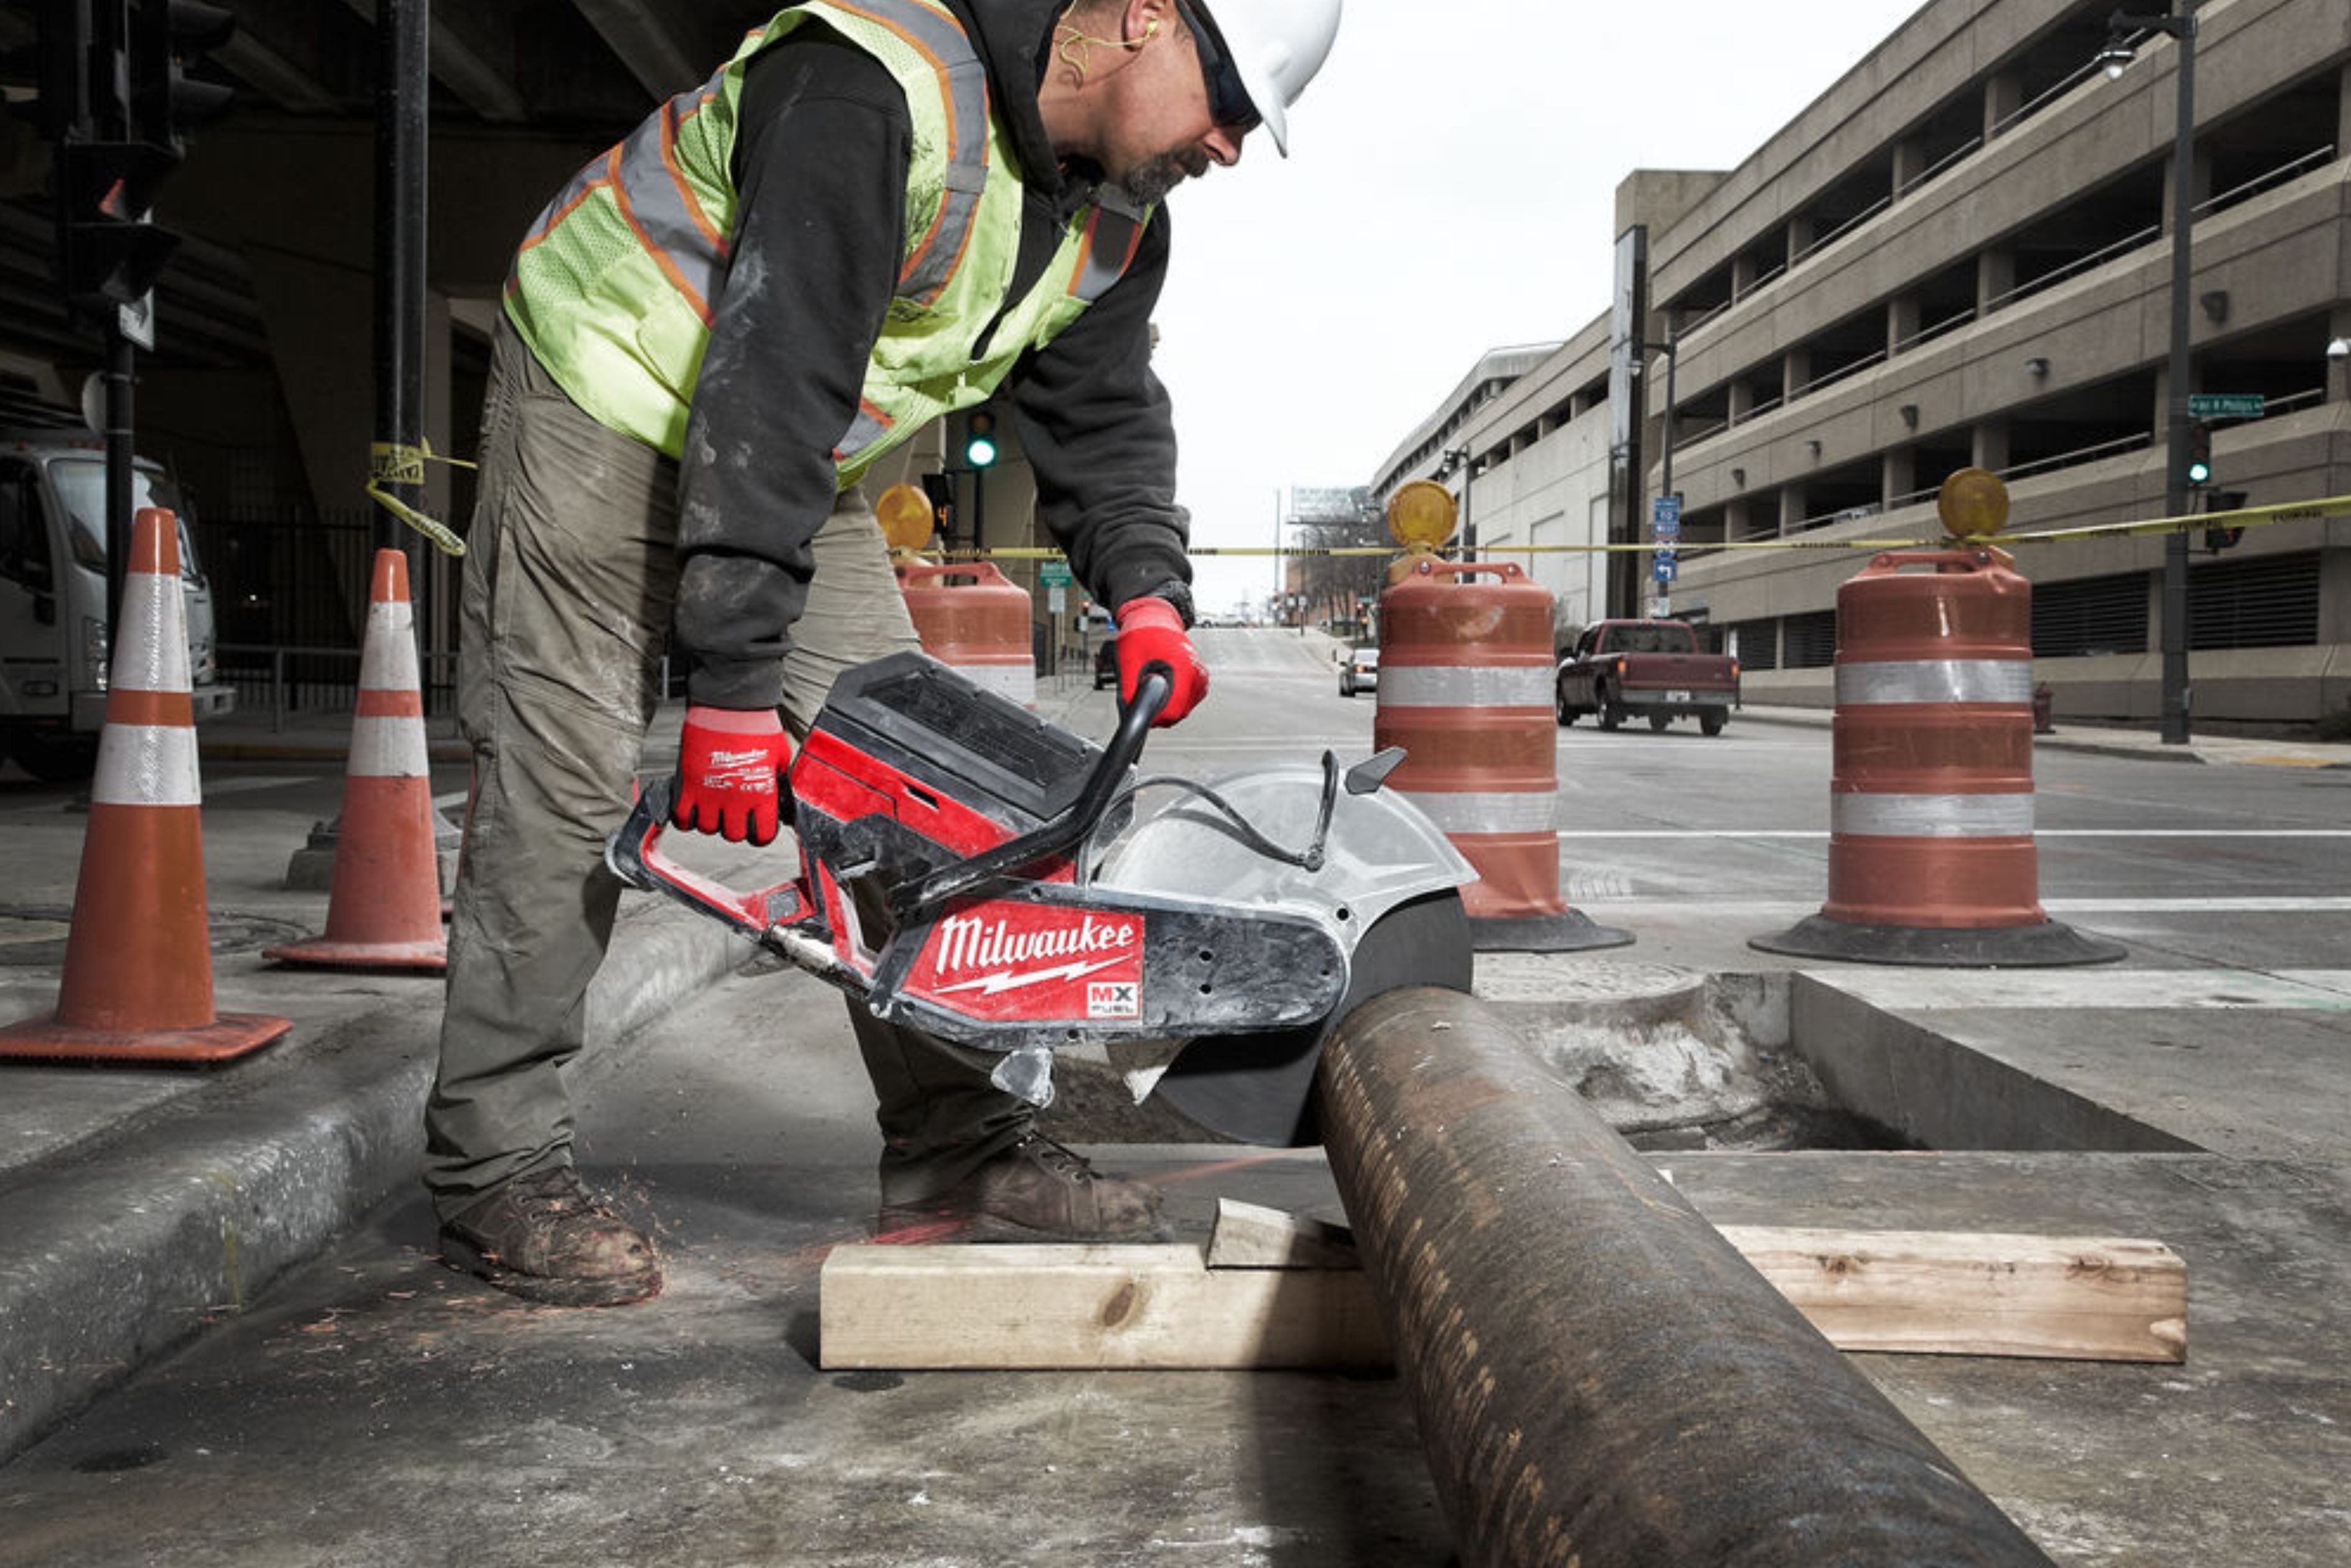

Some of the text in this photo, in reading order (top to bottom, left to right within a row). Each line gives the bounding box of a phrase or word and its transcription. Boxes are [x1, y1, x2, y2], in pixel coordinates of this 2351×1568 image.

[936, 915, 1134, 975] Milwaukee
[1092, 986, 1133, 1002] MX
[1092, 1006, 1133, 1014] FUEL
